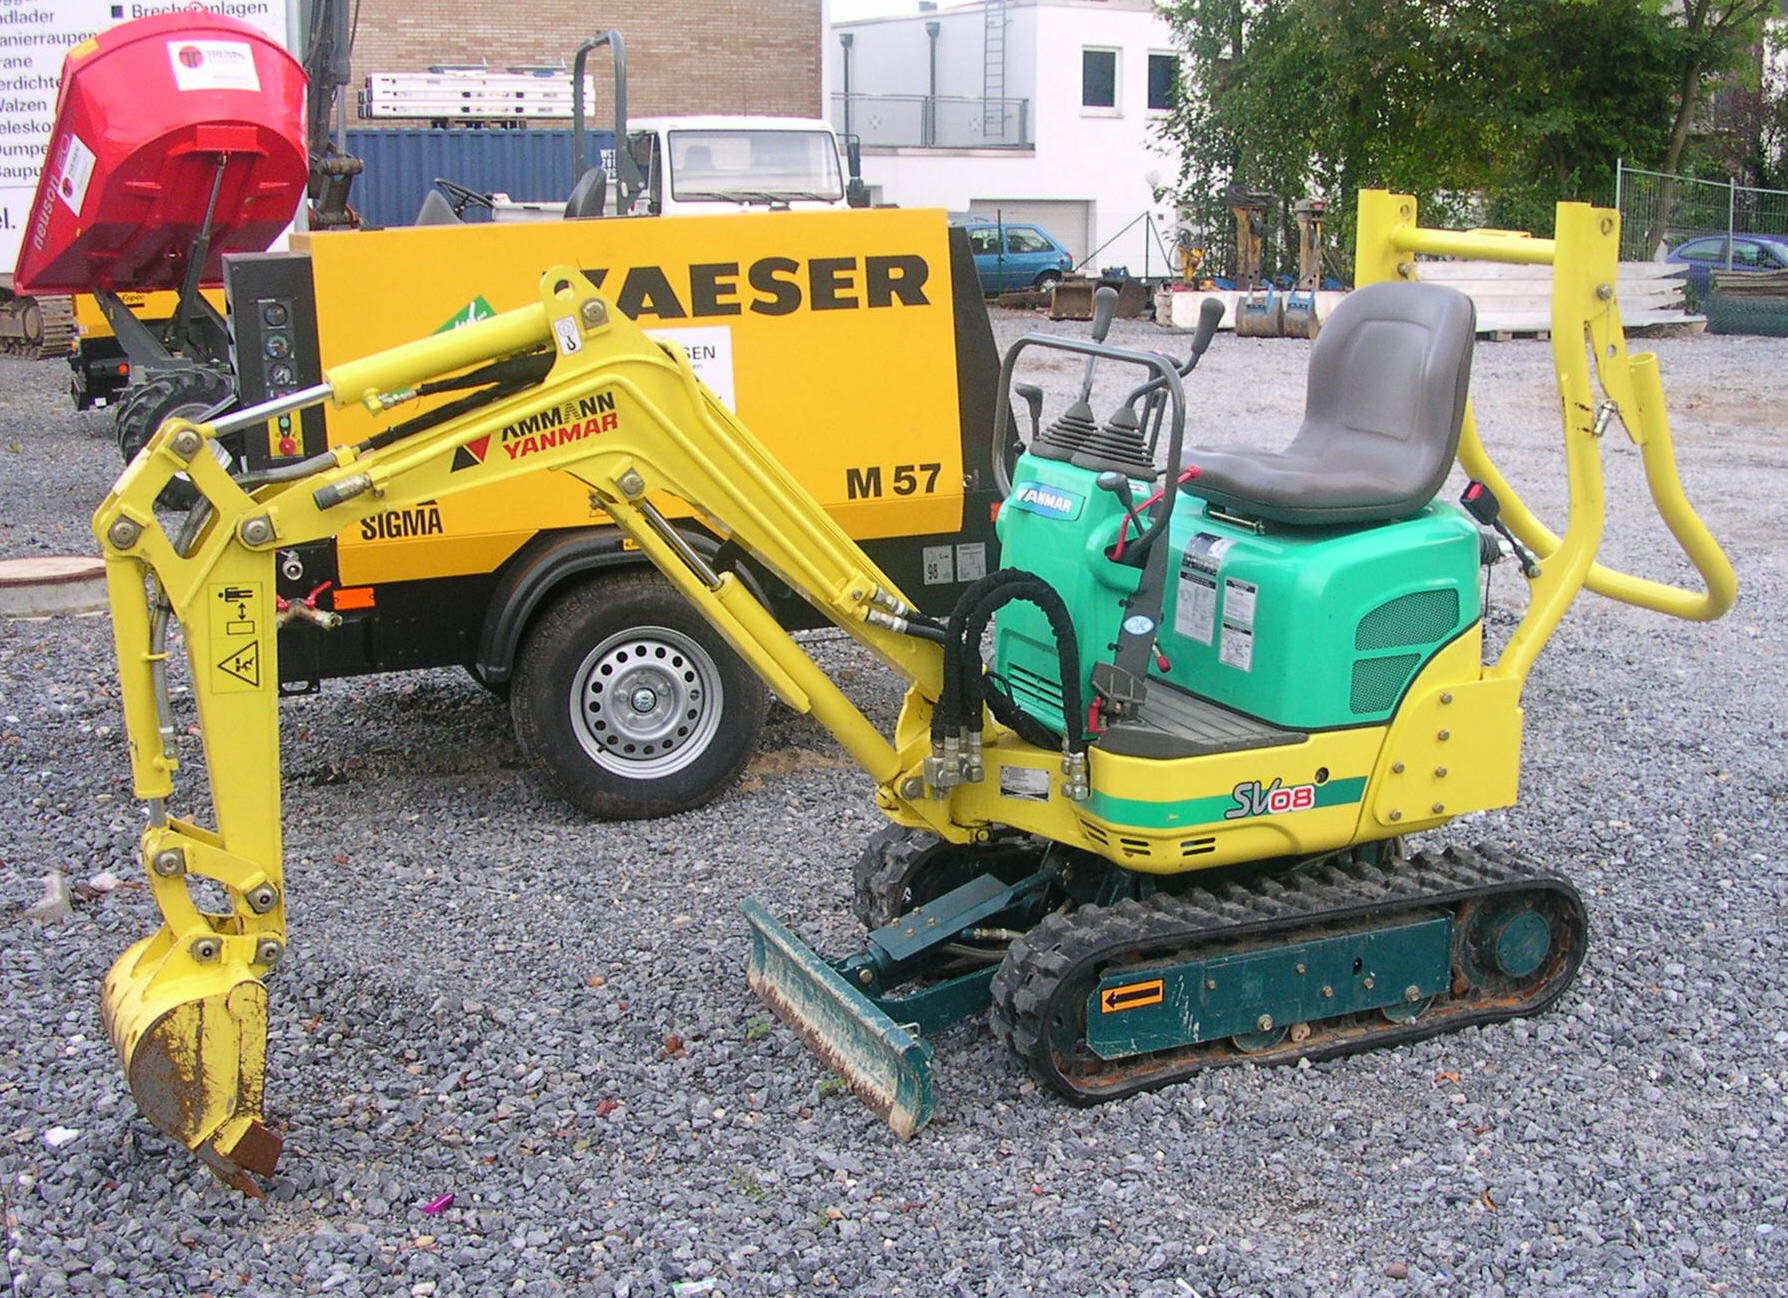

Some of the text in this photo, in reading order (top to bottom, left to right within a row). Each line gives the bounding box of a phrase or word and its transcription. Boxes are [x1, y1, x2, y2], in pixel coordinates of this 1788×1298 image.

[502, 391, 616, 442] AMMANN
[503, 412, 618, 460] YANMAR
[846, 463, 942, 500] M 57
[1015, 487, 1073, 514] YANMAR
[360, 507, 443, 541] SIGMA
